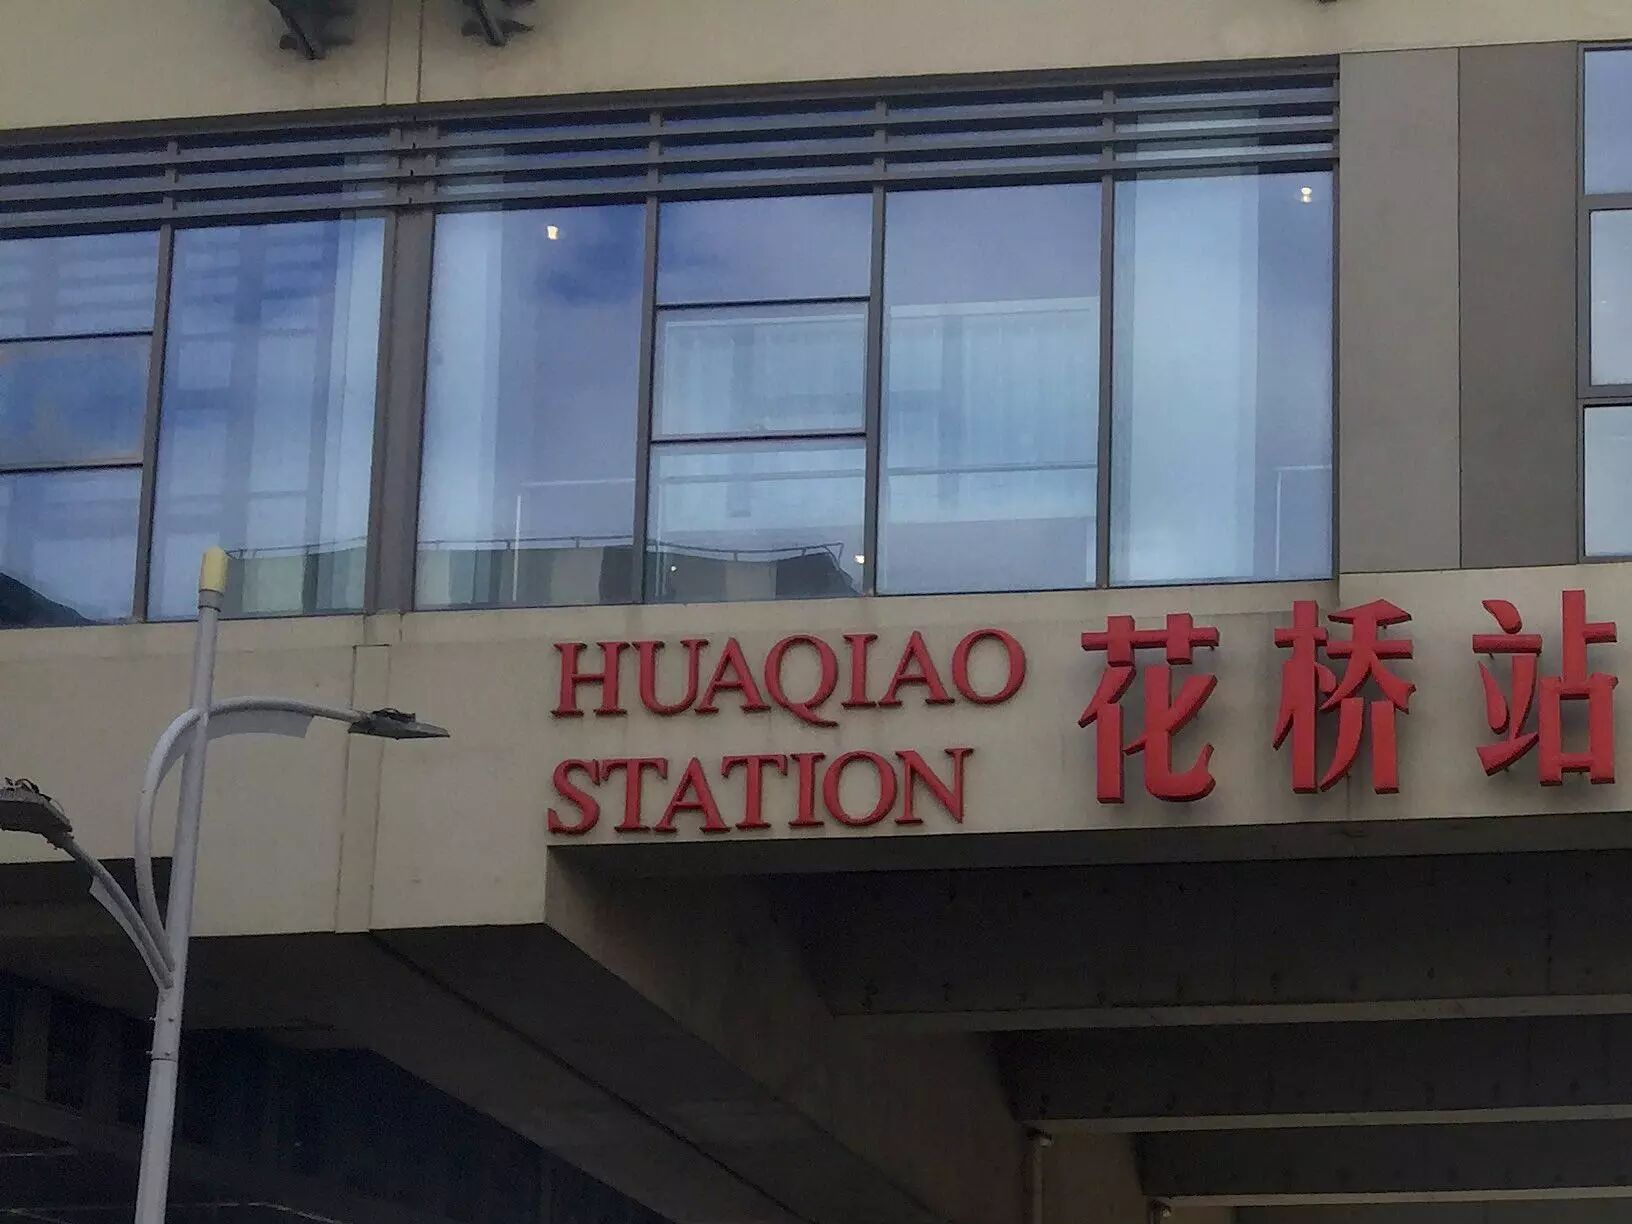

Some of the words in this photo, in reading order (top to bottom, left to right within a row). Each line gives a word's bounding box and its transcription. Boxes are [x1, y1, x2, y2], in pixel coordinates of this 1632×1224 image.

[552, 628, 1027, 727] HUAQIAO
[1078, 589, 1618, 804] 花桥站
[547, 746, 974, 837] STATION
